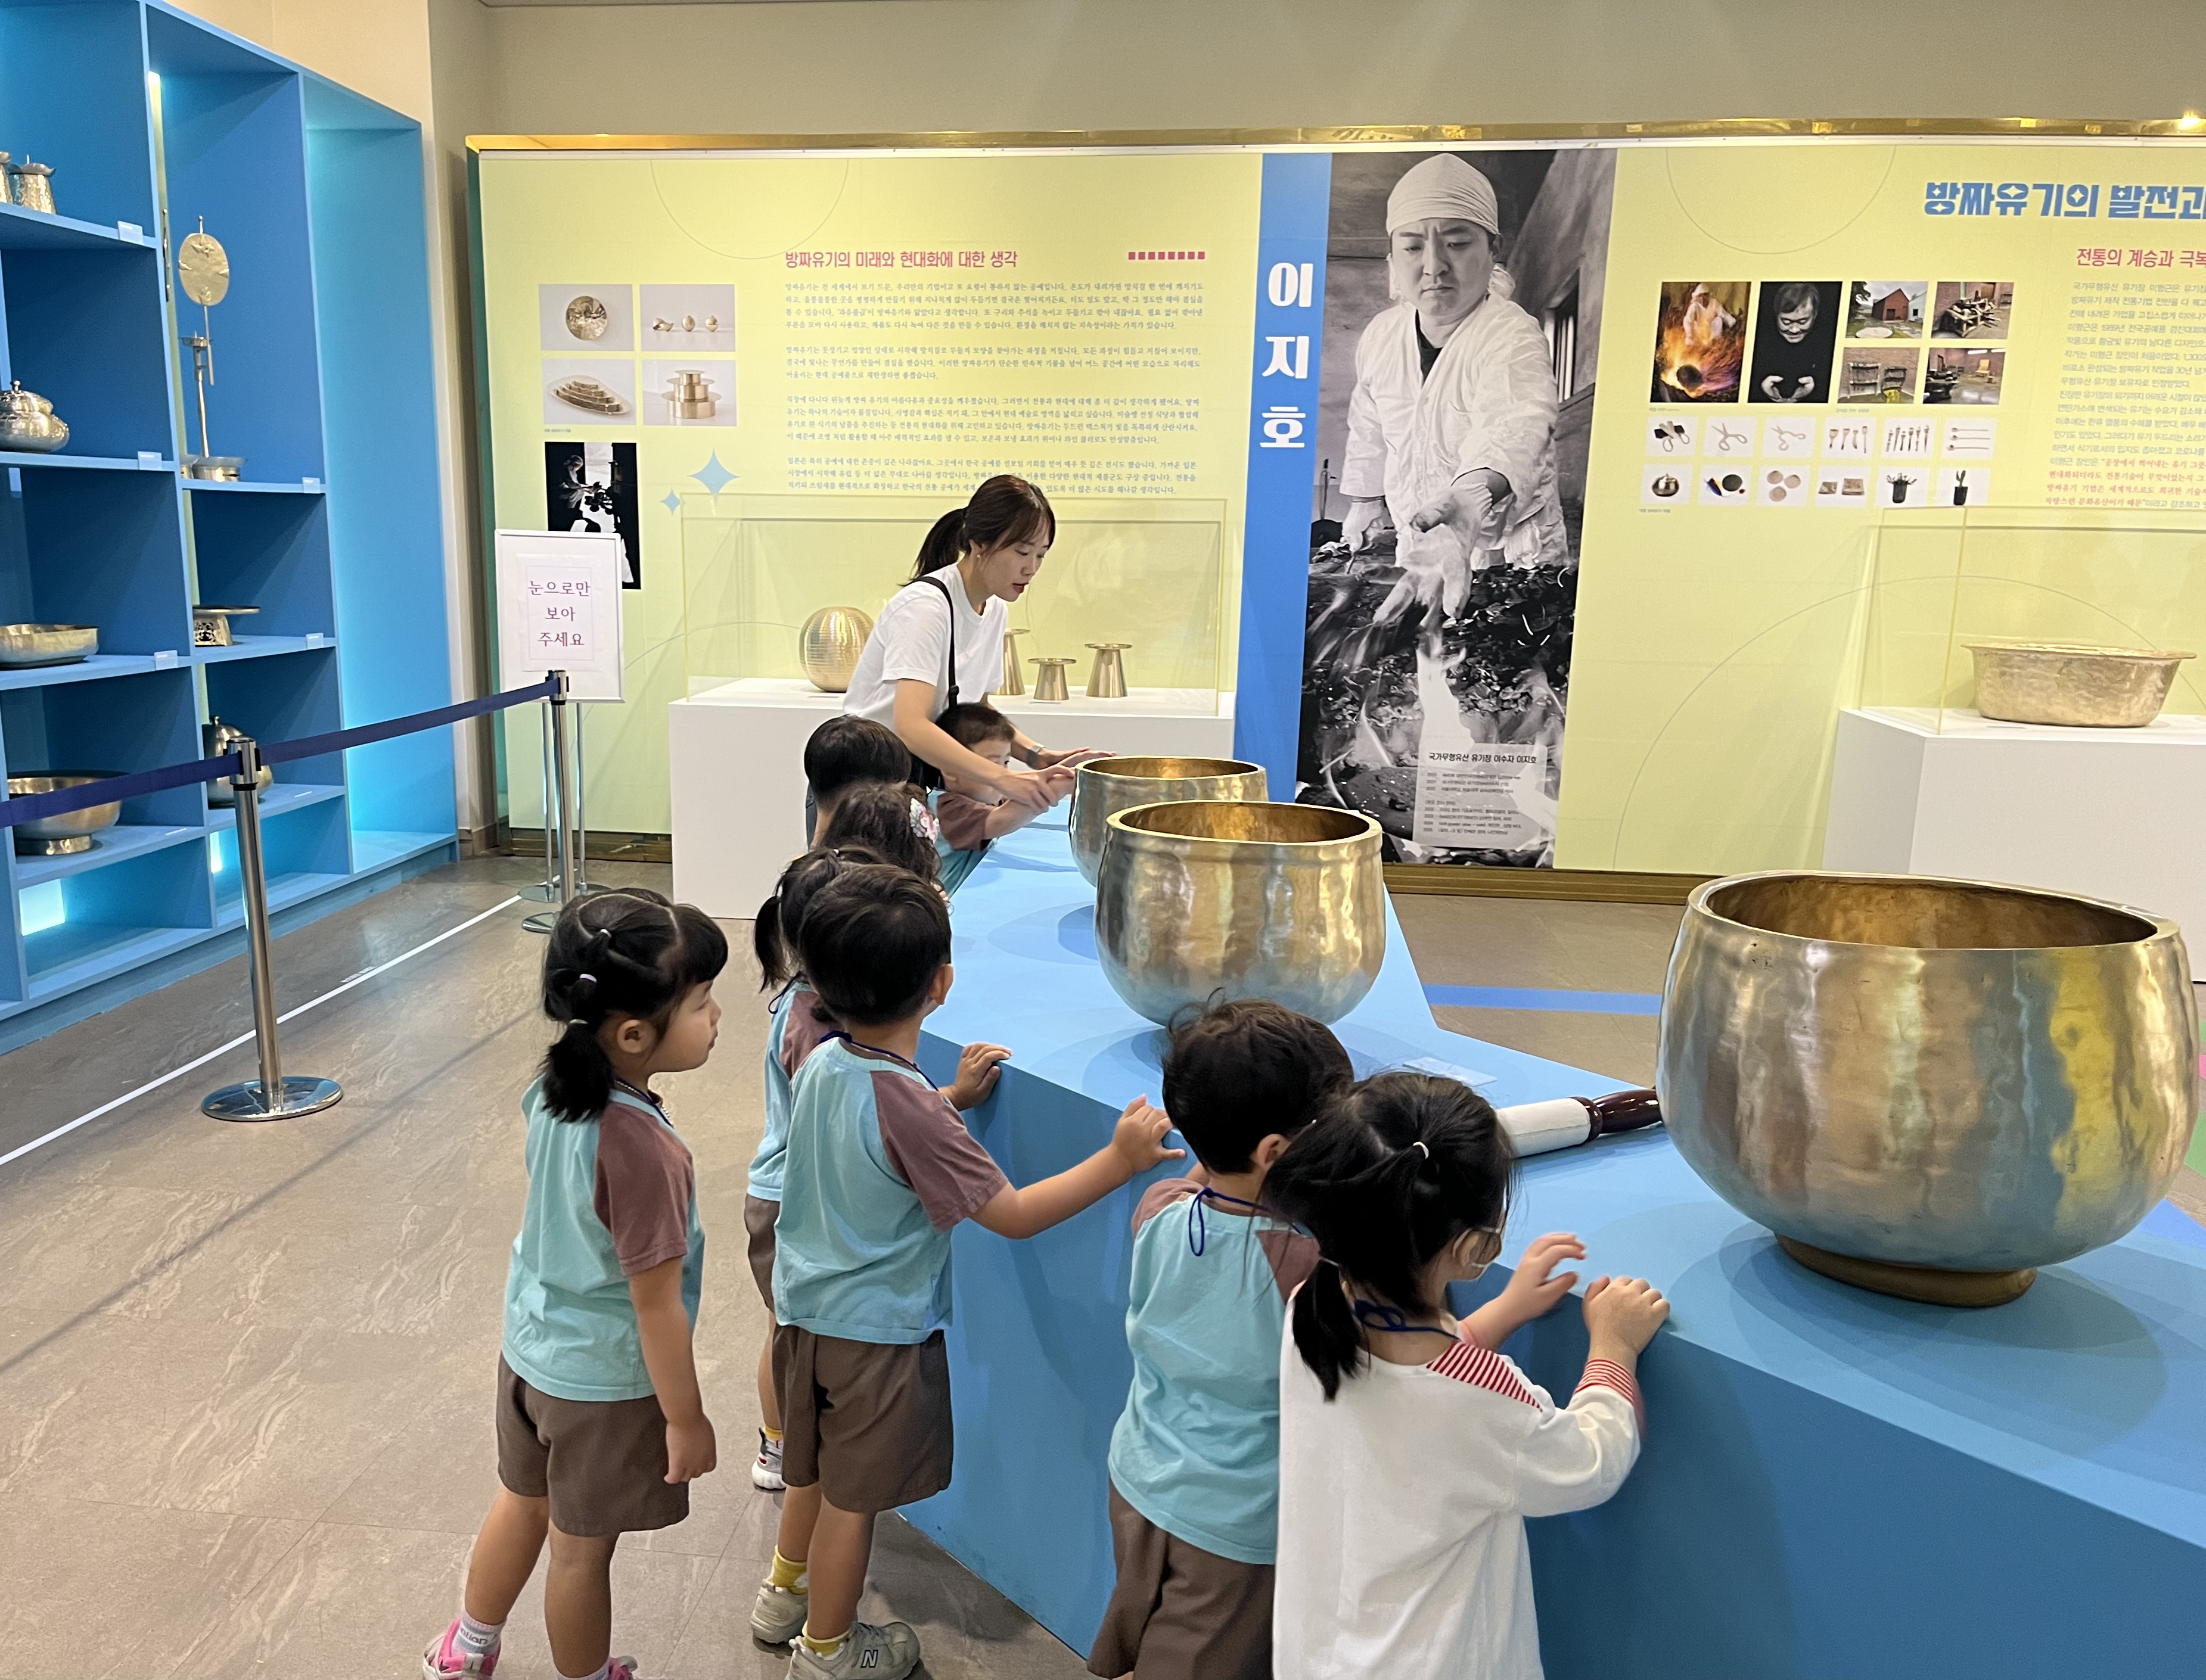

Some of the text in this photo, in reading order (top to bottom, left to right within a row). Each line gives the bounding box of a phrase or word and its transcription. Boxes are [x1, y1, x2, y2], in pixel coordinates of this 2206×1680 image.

[1924, 182, 2099, 217] 방짜유기의
[785, 251, 1018, 268] 방짜유기의 미래와 현대화에 대한 생각
[2077, 248, 2122, 266] 전통의
[2127, 250, 2174, 267] 계승과
[1260, 262, 1313, 447] 이지호
[528, 580, 591, 597] 눈으로만
[545, 606, 576, 621] 보아
[537, 631, 585, 647] 주세요
[1471, 754, 1492, 763] 유기장
[1494, 754, 1514, 763] 이수자
[1517, 755, 1537, 764] 이지호
[860, 1650, 878, 1668] N
